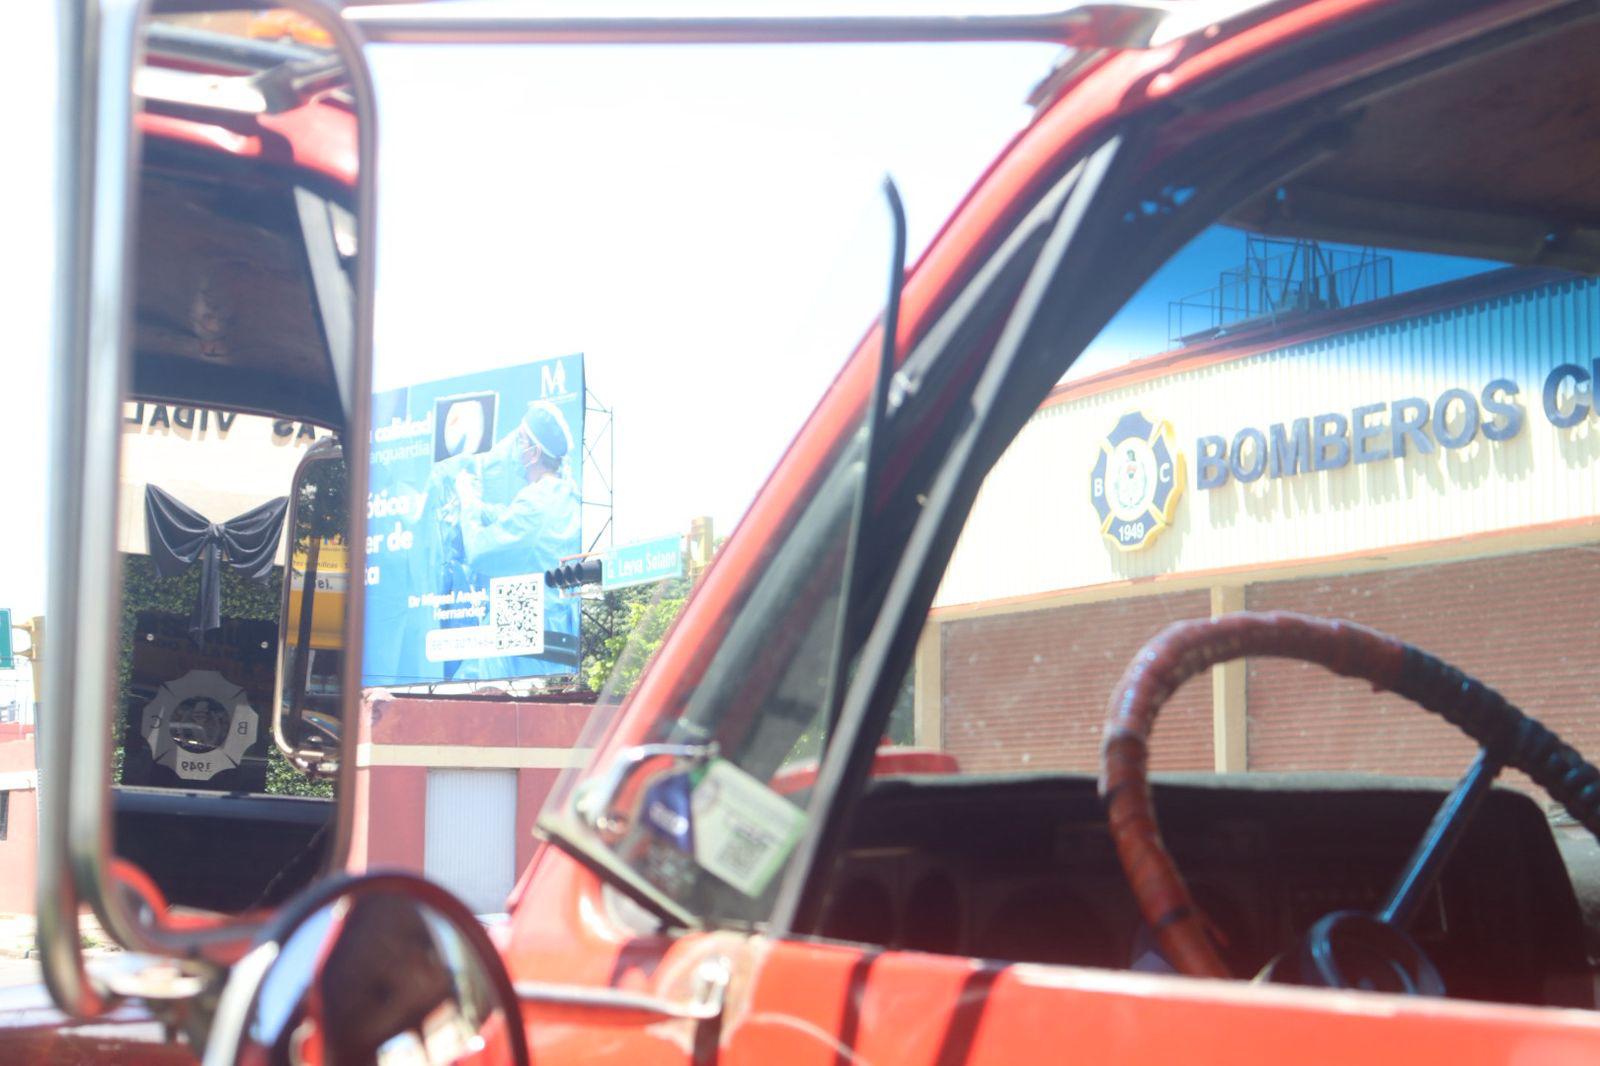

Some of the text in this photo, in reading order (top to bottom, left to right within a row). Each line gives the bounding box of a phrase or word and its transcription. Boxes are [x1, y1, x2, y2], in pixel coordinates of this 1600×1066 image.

[1196, 357, 1600, 491] BOMBEROS C
[1159, 462, 1171, 483] C
[1094, 477, 1104, 497] B
[387, 521, 414, 551] de
[1118, 521, 1145, 541] 1949
